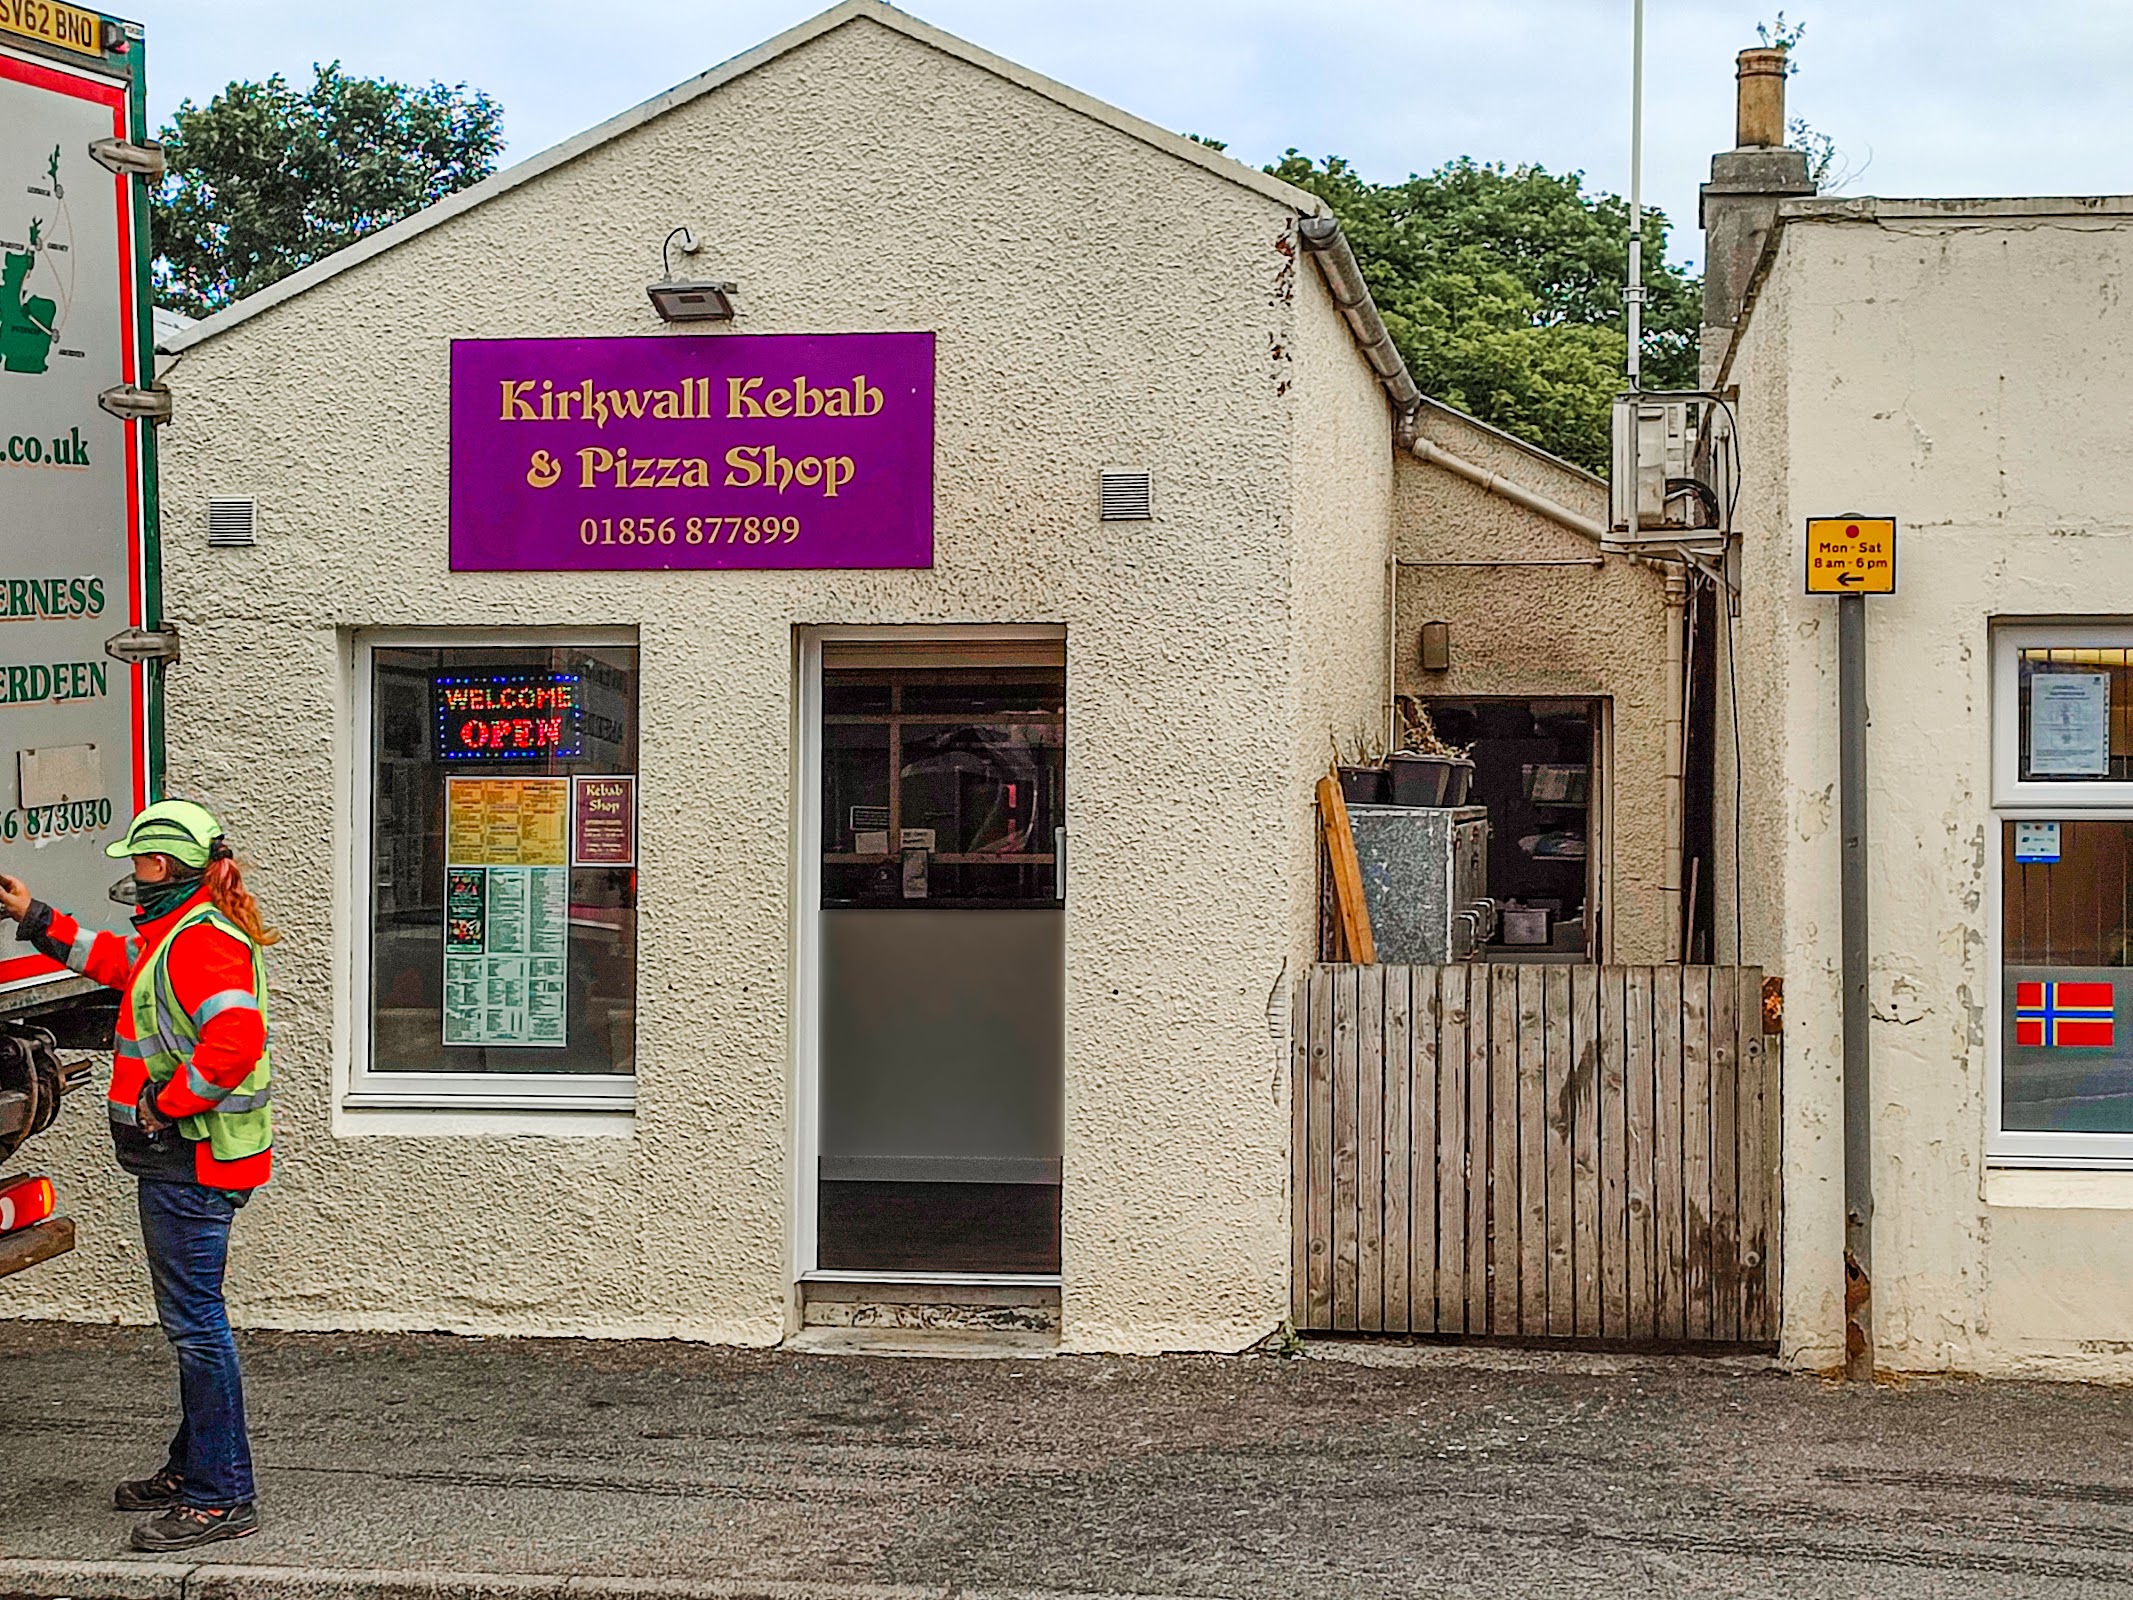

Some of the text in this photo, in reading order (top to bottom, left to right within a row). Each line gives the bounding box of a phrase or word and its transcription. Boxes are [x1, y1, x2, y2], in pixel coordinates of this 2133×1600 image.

[54, 7, 93, 48] BNO
[499, 374, 884, 429] Kirkwall Kebab
[526, 444, 856, 497] & Pizza Shop
[579, 515, 801, 546] 01856 877899
[1819, 542, 1848, 553] Mon
[1858, 541, 1882, 553] Sat
[444, 686, 573, 711] WELCOME
[459, 716, 563, 748] OPEN
[586, 783, 624, 797] Kebab
[26, 797, 112, 836] 873030
[588, 798, 621, 814] Shop
